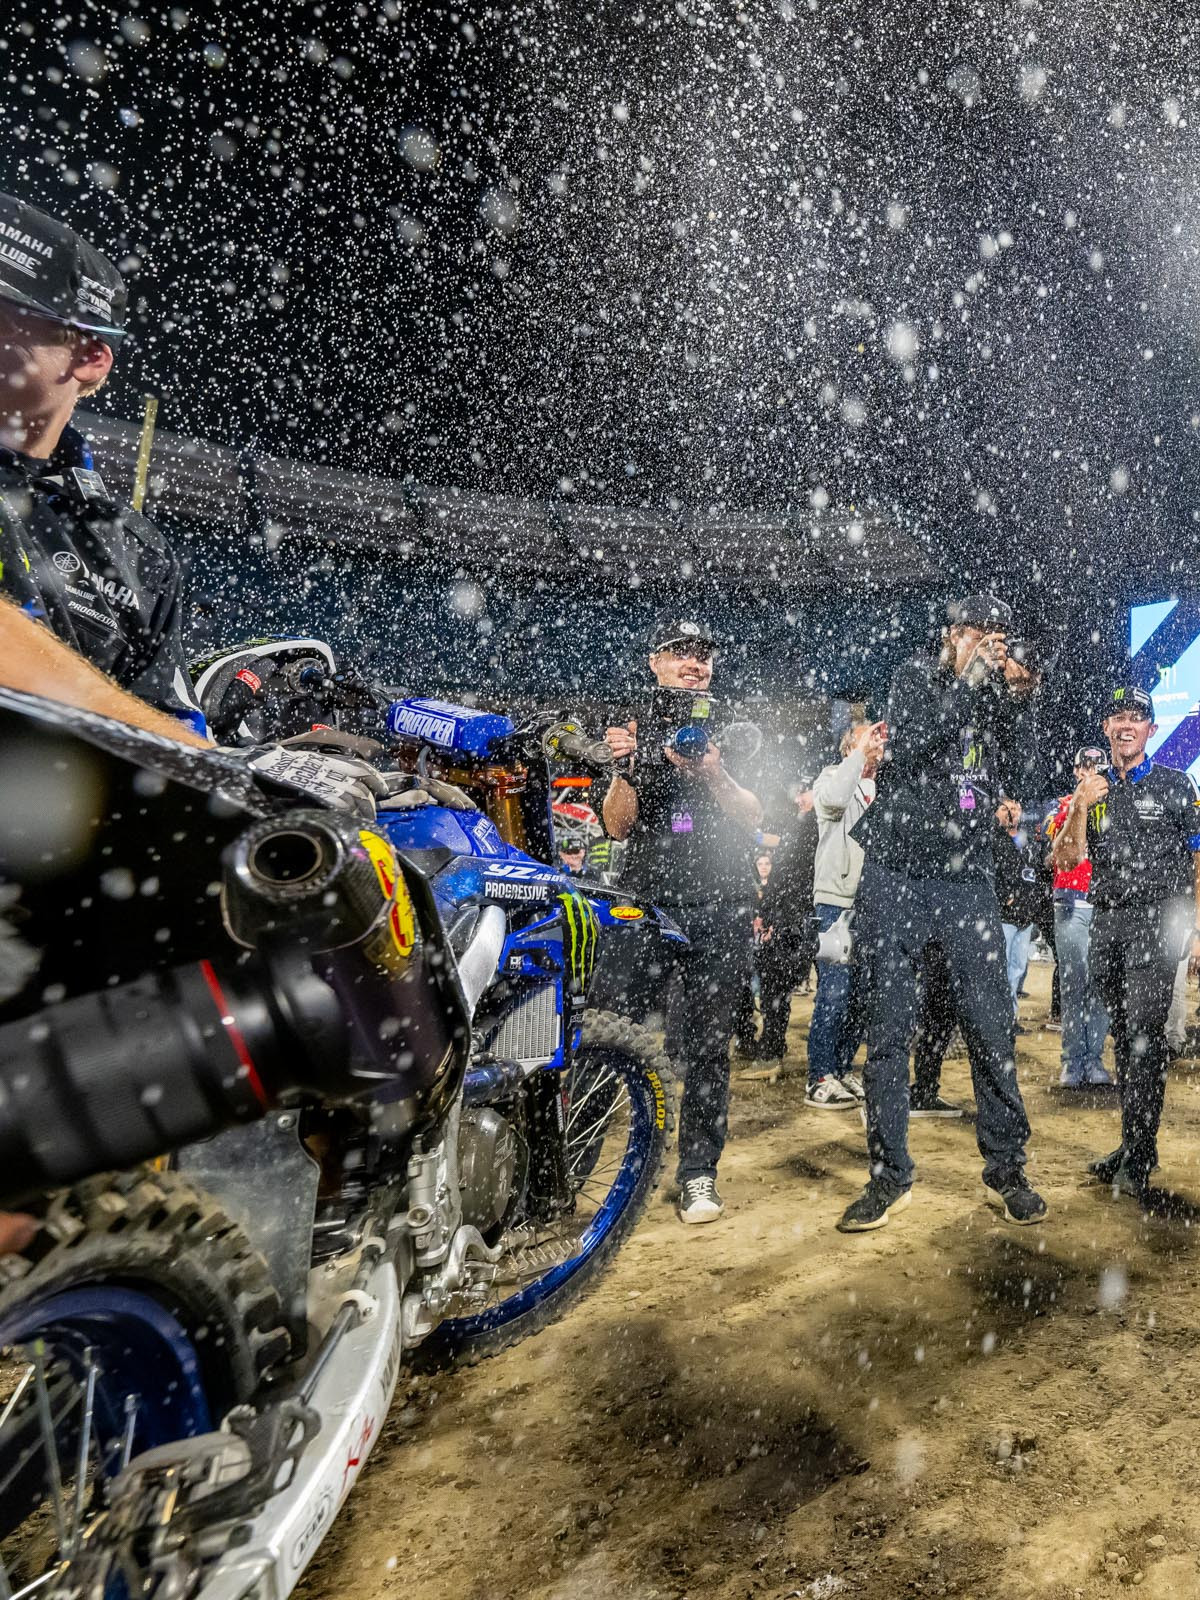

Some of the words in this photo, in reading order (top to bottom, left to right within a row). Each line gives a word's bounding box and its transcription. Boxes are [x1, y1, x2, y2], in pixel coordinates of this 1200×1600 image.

[399, 708, 454, 745] PROTAPER
[483, 863, 538, 880] YZ
[484, 881, 548, 901] PROGRESSIVE
[613, 908, 643, 919] FMF
[646, 1069, 666, 1130] DUNLOP
